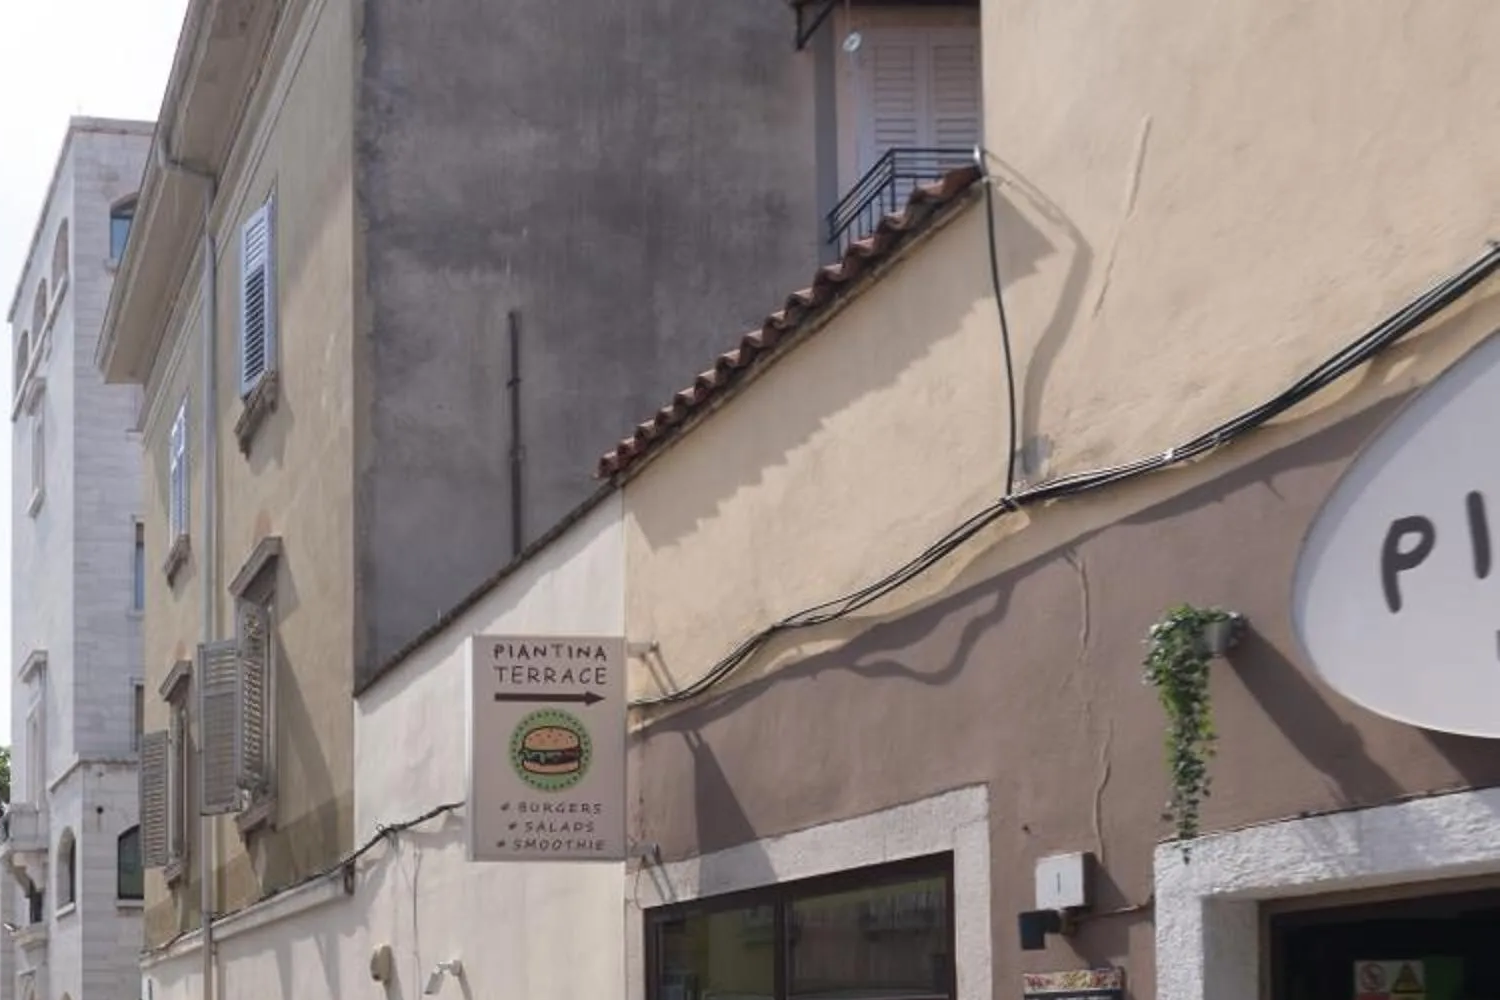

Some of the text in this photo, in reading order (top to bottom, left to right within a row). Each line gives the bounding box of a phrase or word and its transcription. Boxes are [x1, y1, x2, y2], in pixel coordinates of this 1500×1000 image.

[493, 643, 607, 661] PIANTINA
[493, 665, 607, 685] TERRACE
[518, 801, 602, 815] BURGERS
[524, 821, 595, 833] SALADS
[512, 838, 605, 851] SMOOTHIE
